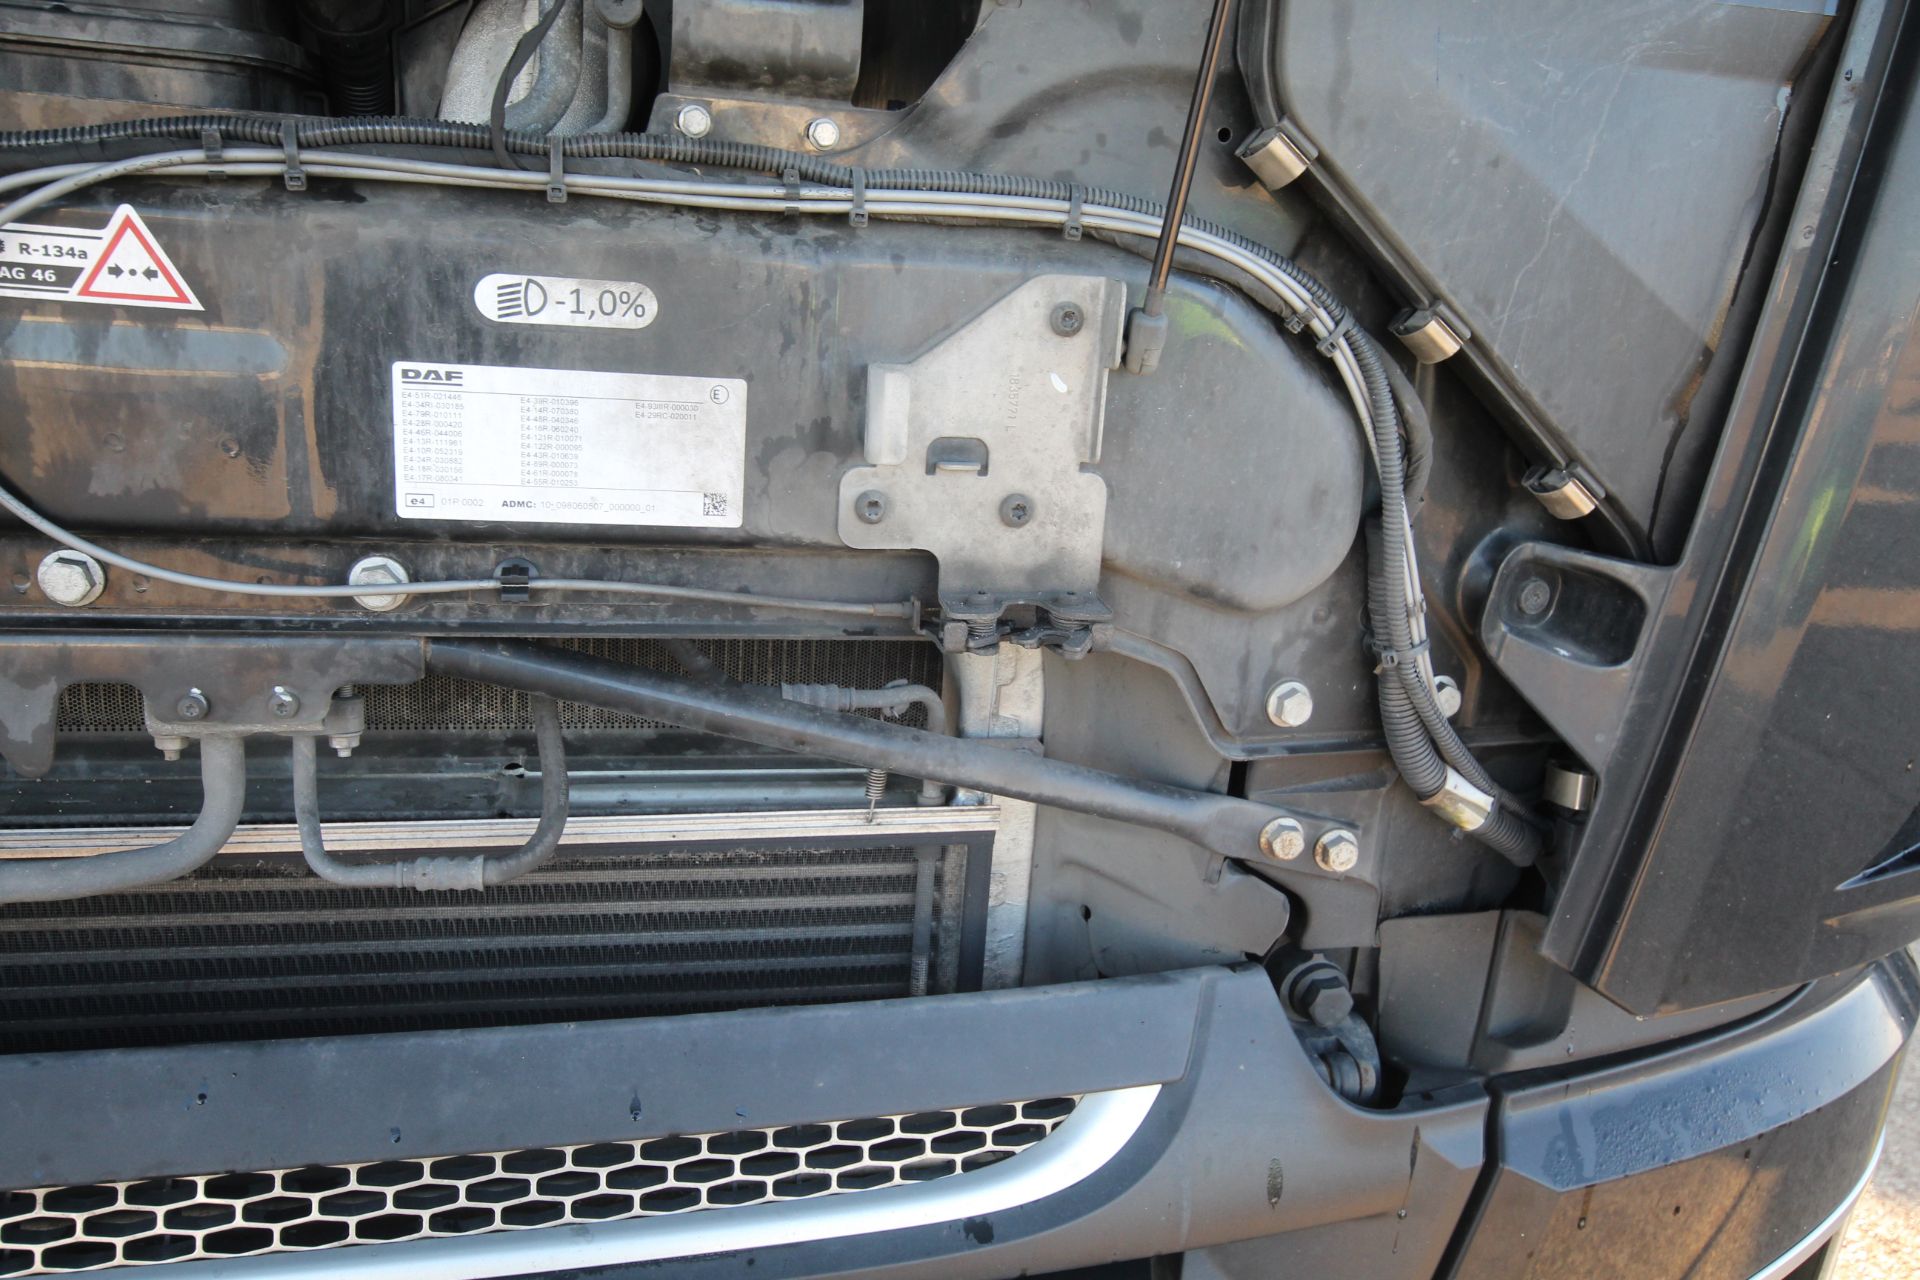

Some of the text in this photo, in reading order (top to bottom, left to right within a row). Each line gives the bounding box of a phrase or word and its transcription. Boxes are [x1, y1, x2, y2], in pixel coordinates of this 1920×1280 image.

[18, 242, 88, 260] R-134a
[31, 268, 57, 282] 46
[555, 288, 646, 320] -1,0%
[401, 368, 463, 381] DAF
[410, 497, 425, 505] e4
[501, 499, 537, 509] ADMC:
